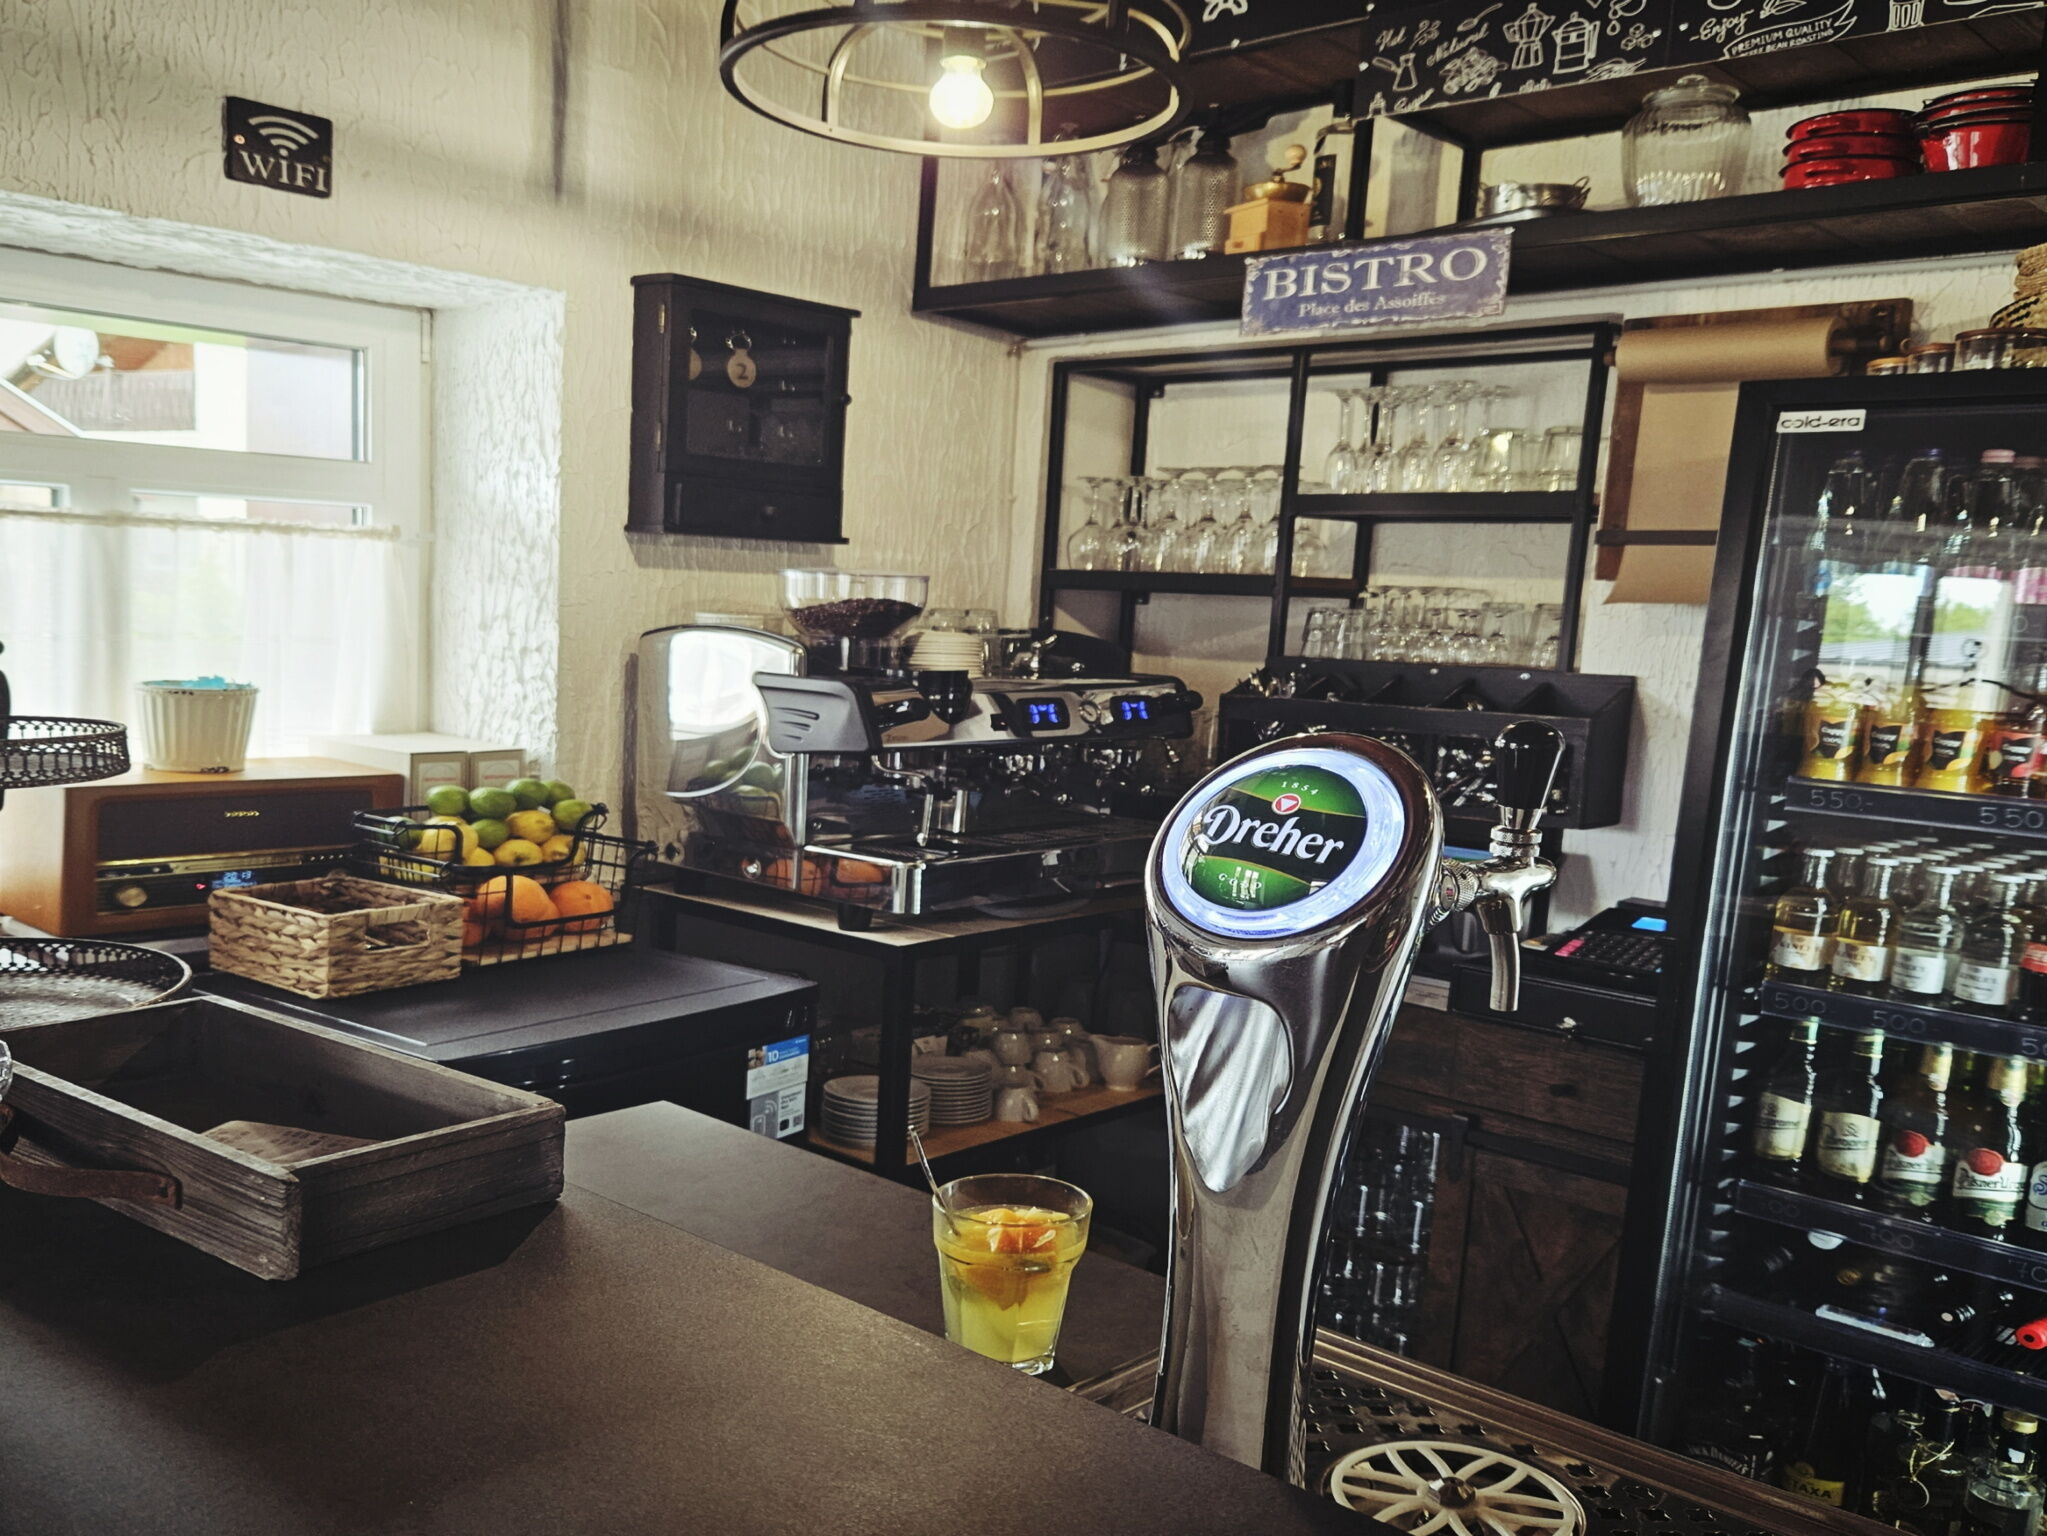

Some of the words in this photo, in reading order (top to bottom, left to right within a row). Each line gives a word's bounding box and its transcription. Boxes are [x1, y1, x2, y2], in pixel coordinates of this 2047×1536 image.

[1699, 11, 1752, 44] Enjoy
[1731, 29, 1784, 56] PREMIUM
[1785, 17, 1834, 38] QUALITY
[1789, 28, 1835, 48] ROASTING
[1263, 247, 1488, 300] BISTRO
[1299, 302, 1341, 318] Place
[1344, 298, 1370, 314] des
[736, 362, 750, 380] 2
[1281, 781, 1319, 795] 1854
[1194, 804, 1345, 864] Dreher
